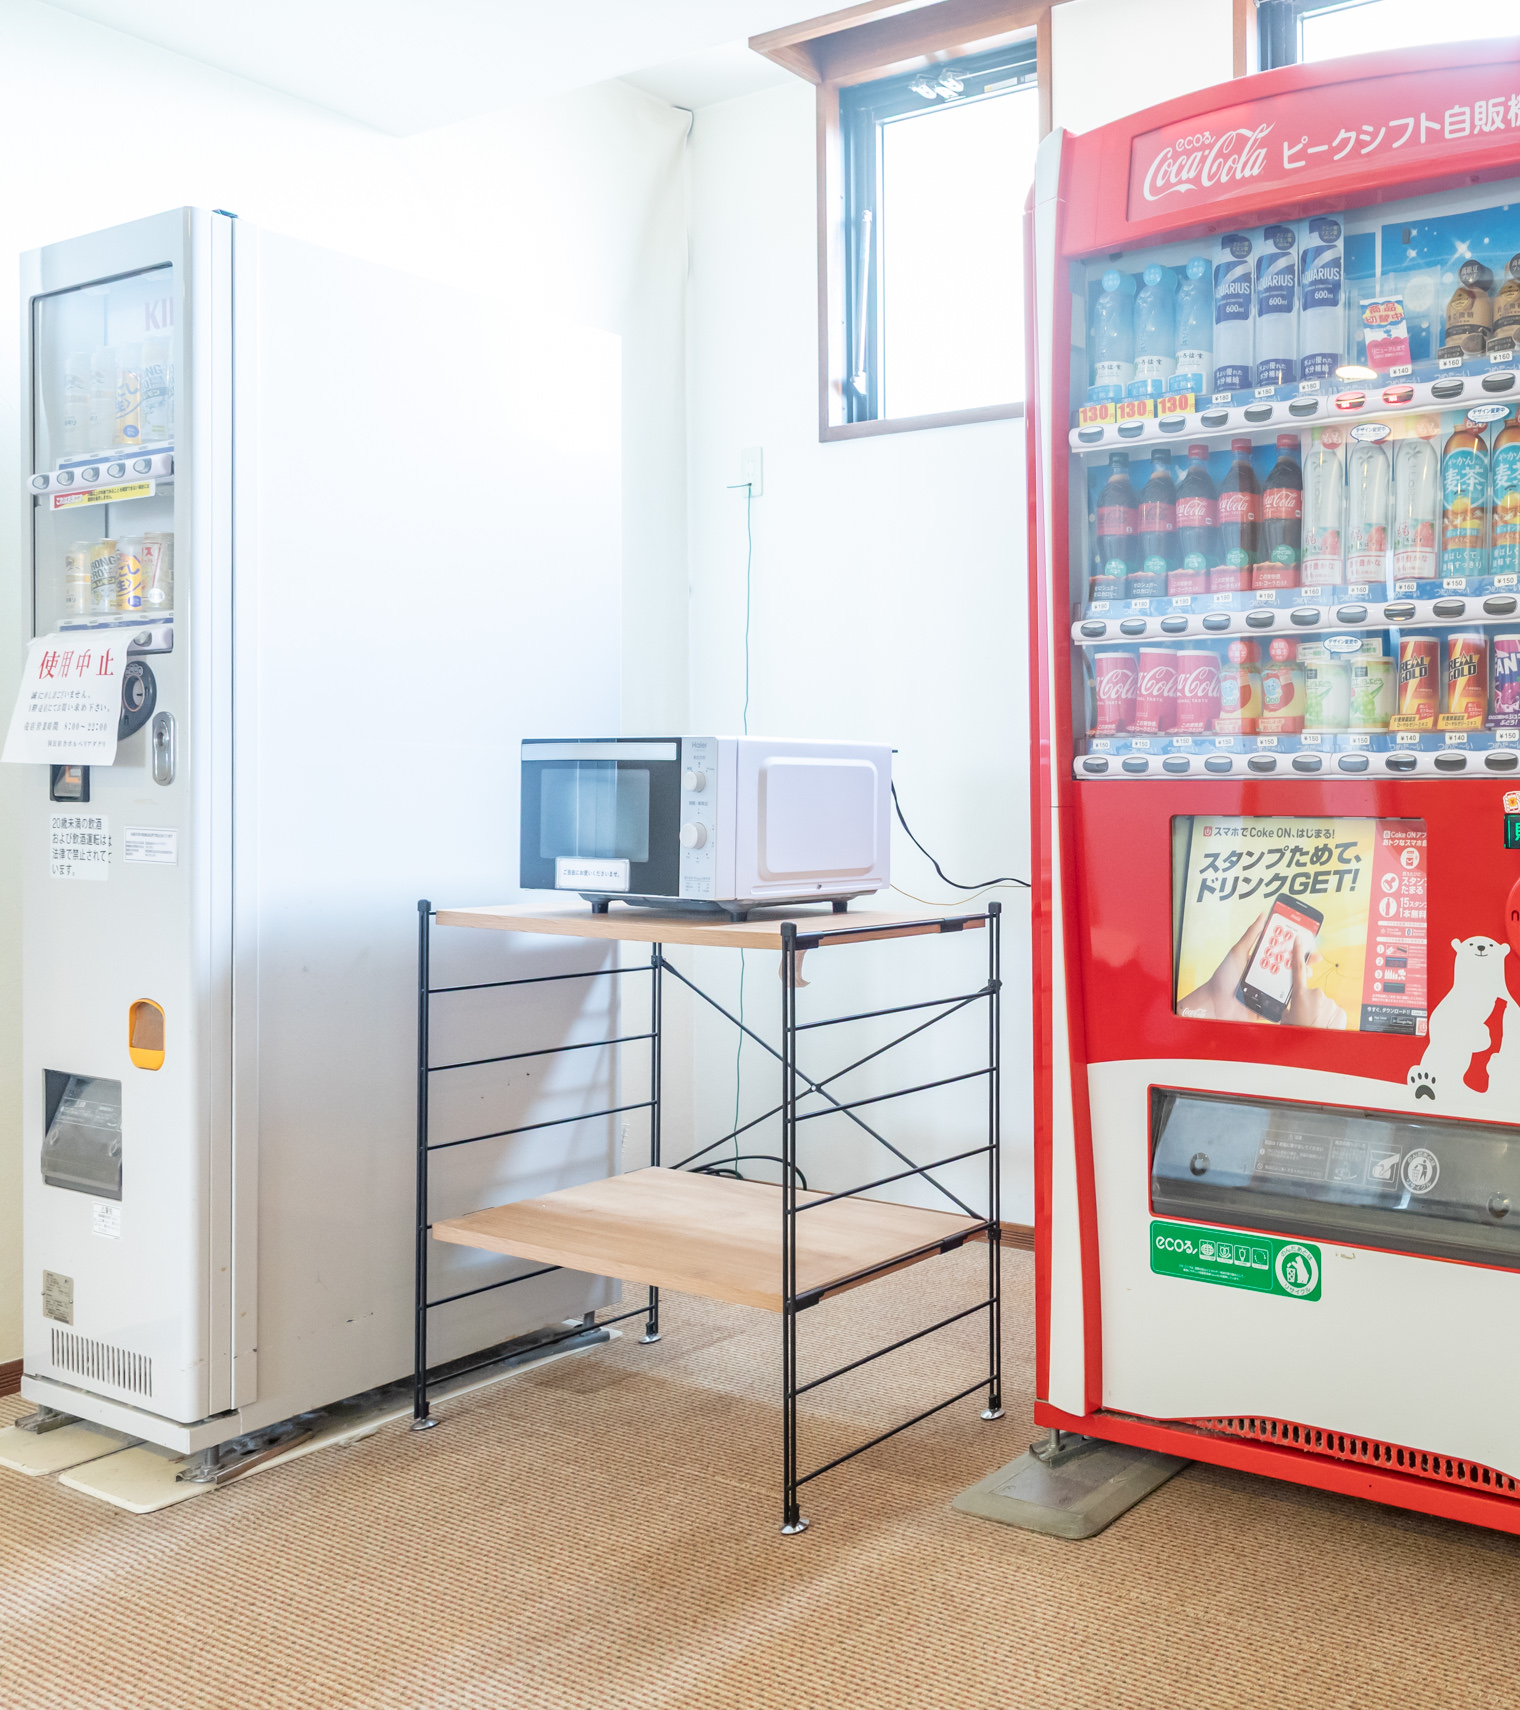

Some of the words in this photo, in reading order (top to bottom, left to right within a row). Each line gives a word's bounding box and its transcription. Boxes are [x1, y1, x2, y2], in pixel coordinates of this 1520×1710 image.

[1143, 120, 1276, 201] Coca-Cola
[39, 648, 114, 679] 使用中止
[1400, 650, 1428, 672] REAL
[1448, 650, 1477, 670] REAL
[1448, 663, 1478, 683] GOLD
[691, 741, 707, 749] Haier
[52, 817, 103, 830] 20歳未満の飲酒
[1199, 841, 1362, 875] スタンプためて、
[52, 864, 76, 877] います。
[1196, 868, 1361, 903] ドリンクGET!
[1401, 877, 1427, 887] スタン
[1401, 886, 1424, 895] たまる
[1400, 897, 1427, 908] 15スタン
